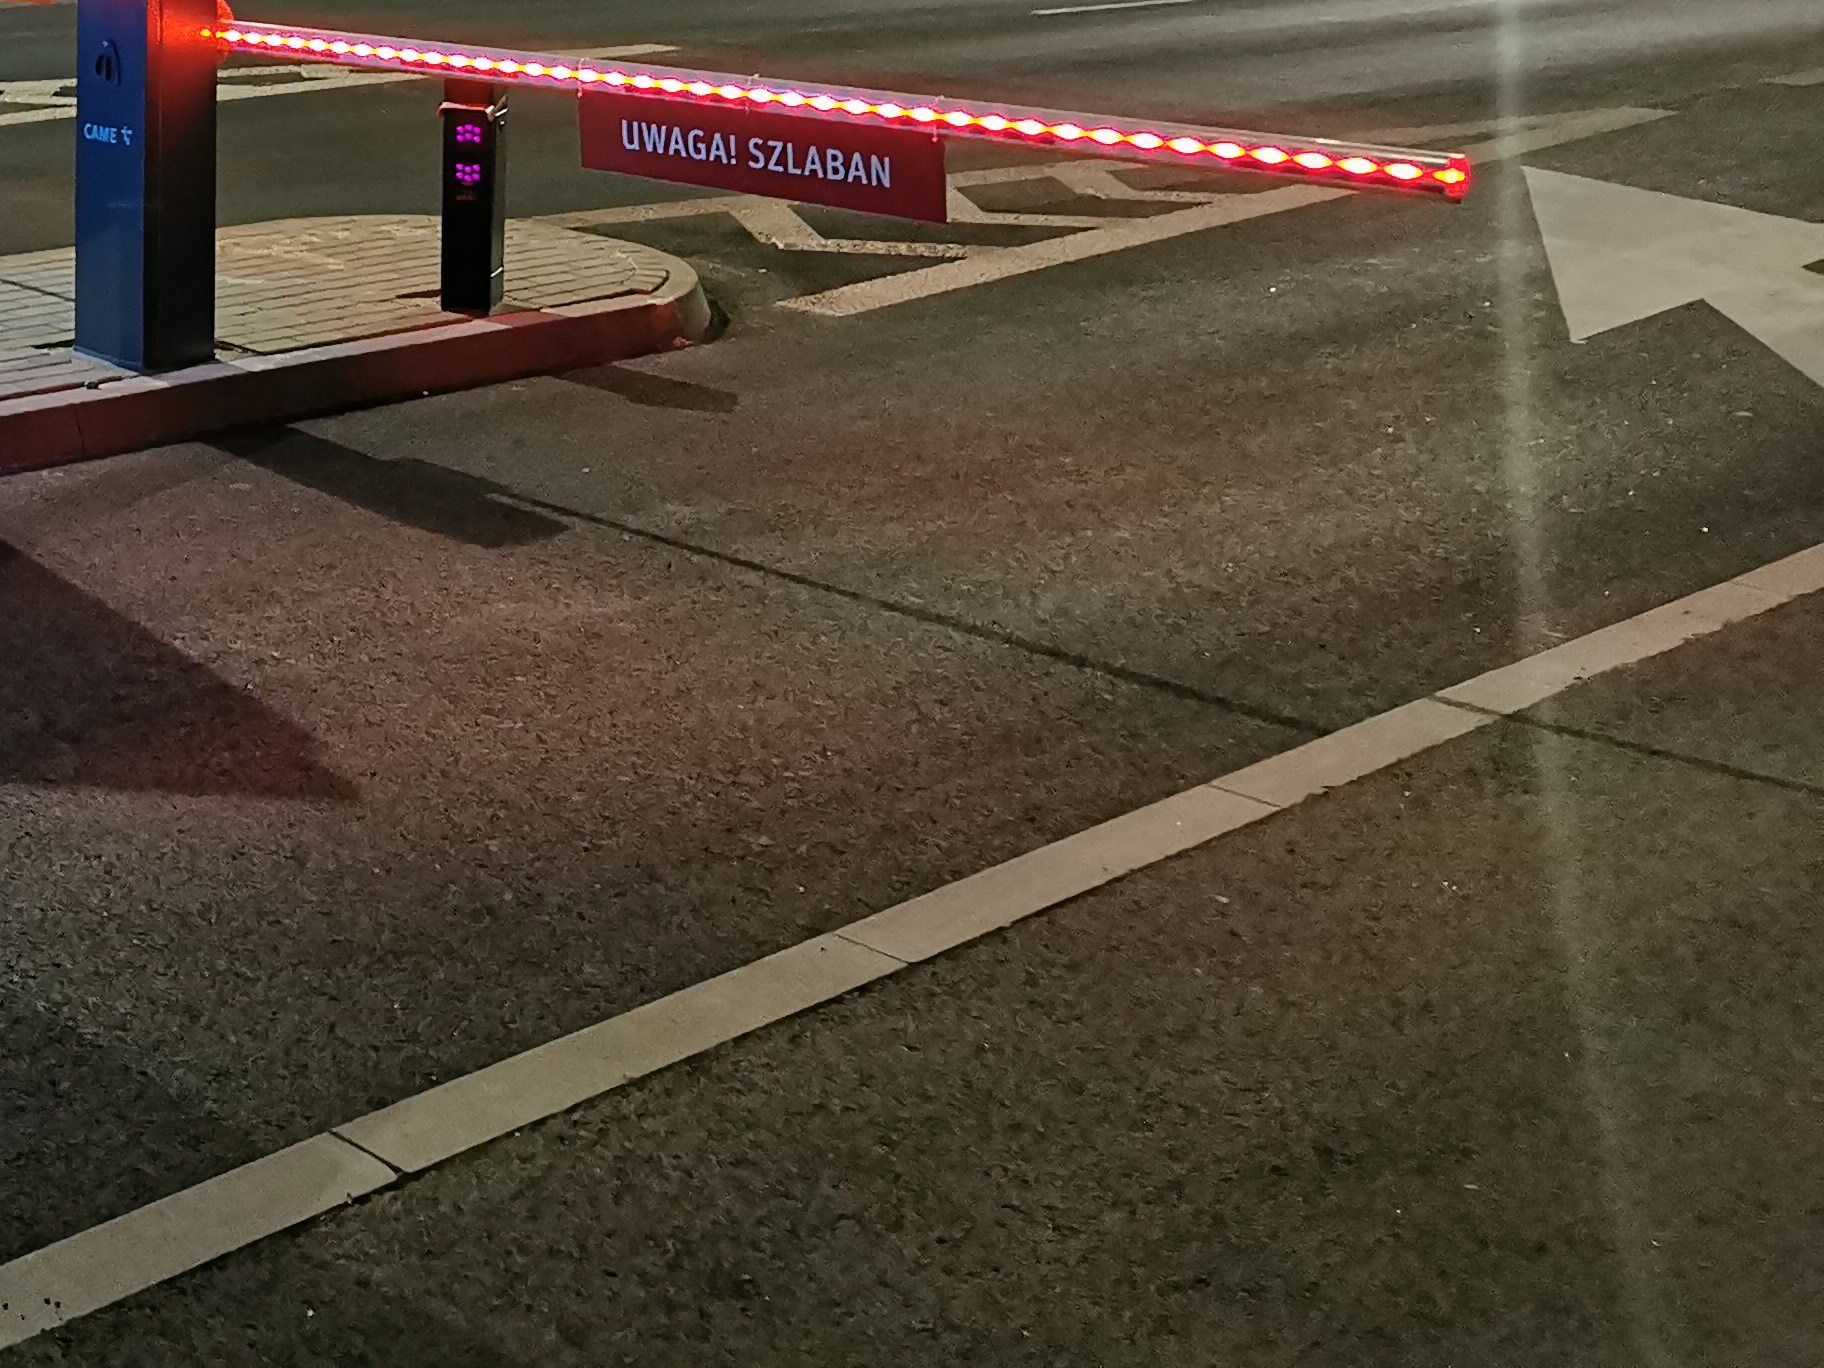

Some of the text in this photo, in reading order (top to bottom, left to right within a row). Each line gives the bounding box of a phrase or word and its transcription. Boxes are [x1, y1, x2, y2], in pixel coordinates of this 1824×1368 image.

[83, 123, 117, 143] CAME
[621, 119, 891, 188] UWAGA! SZLABAN
